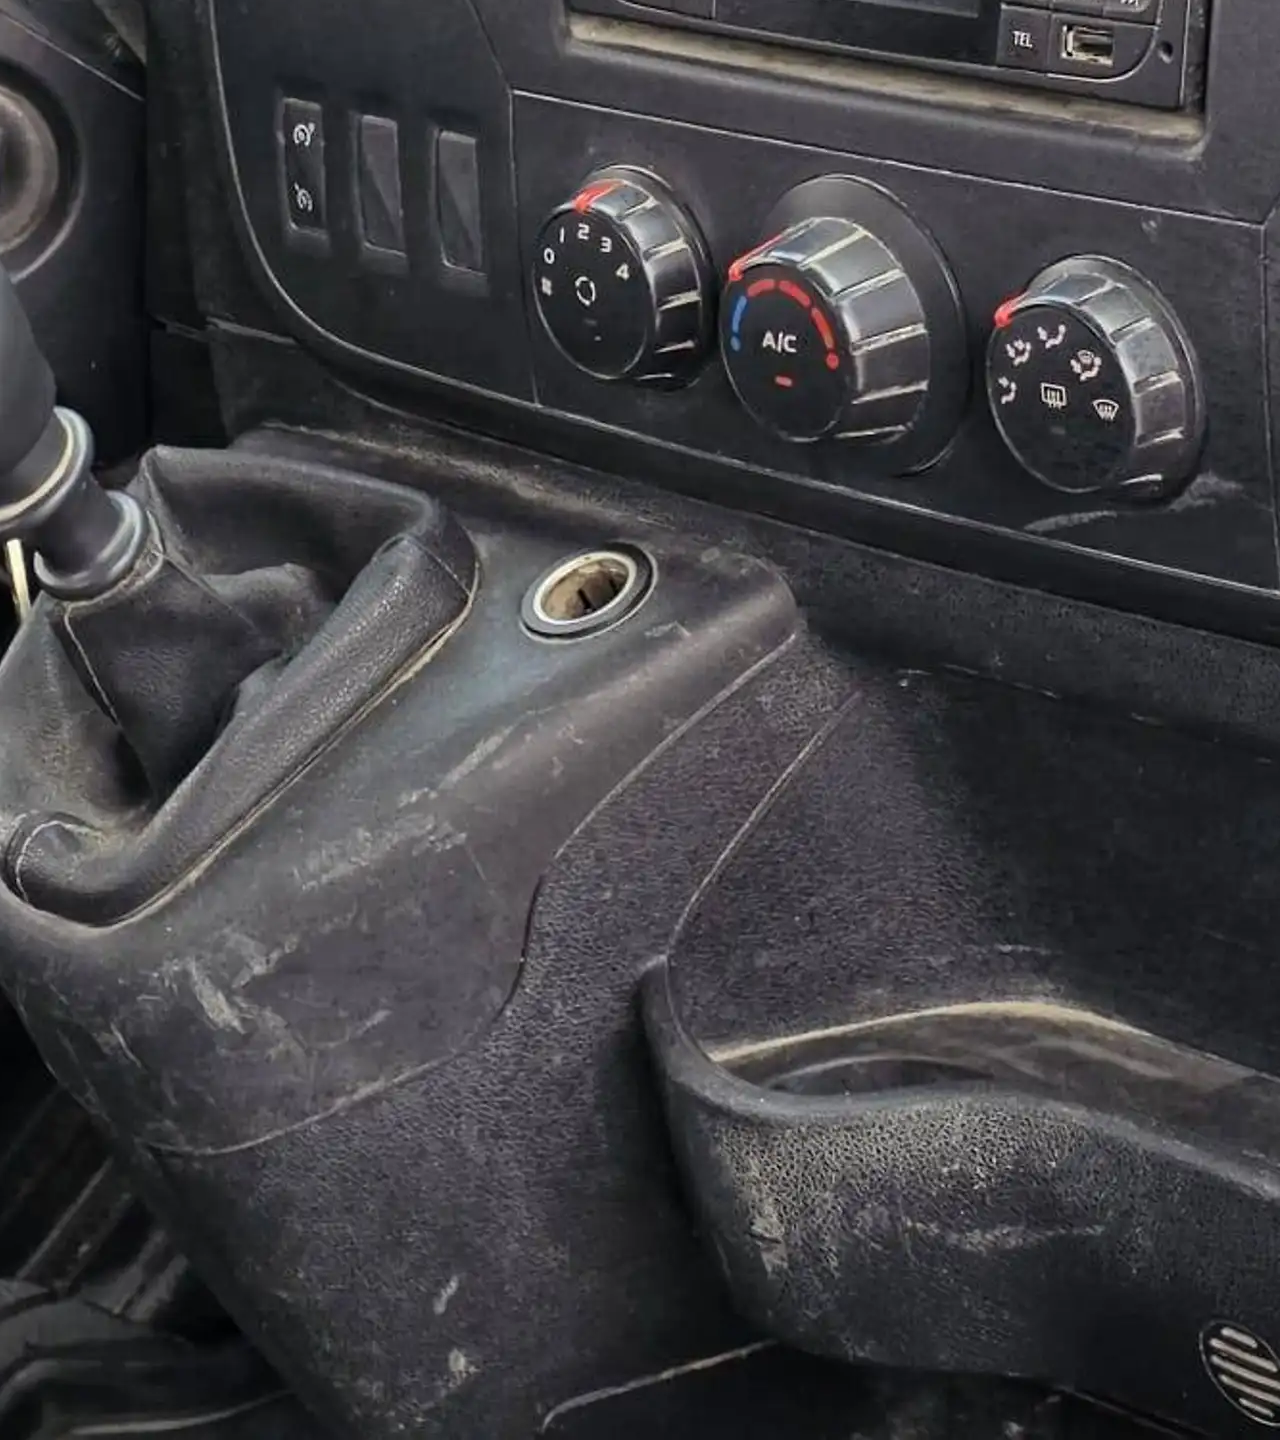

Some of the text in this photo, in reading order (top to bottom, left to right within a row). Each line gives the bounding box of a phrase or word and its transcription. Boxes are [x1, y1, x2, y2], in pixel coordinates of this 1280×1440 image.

[1012, 30, 1034, 49] TEL
[543, 222, 631, 280] 0 1 2 3 4
[762, 329, 798, 354] A/C
